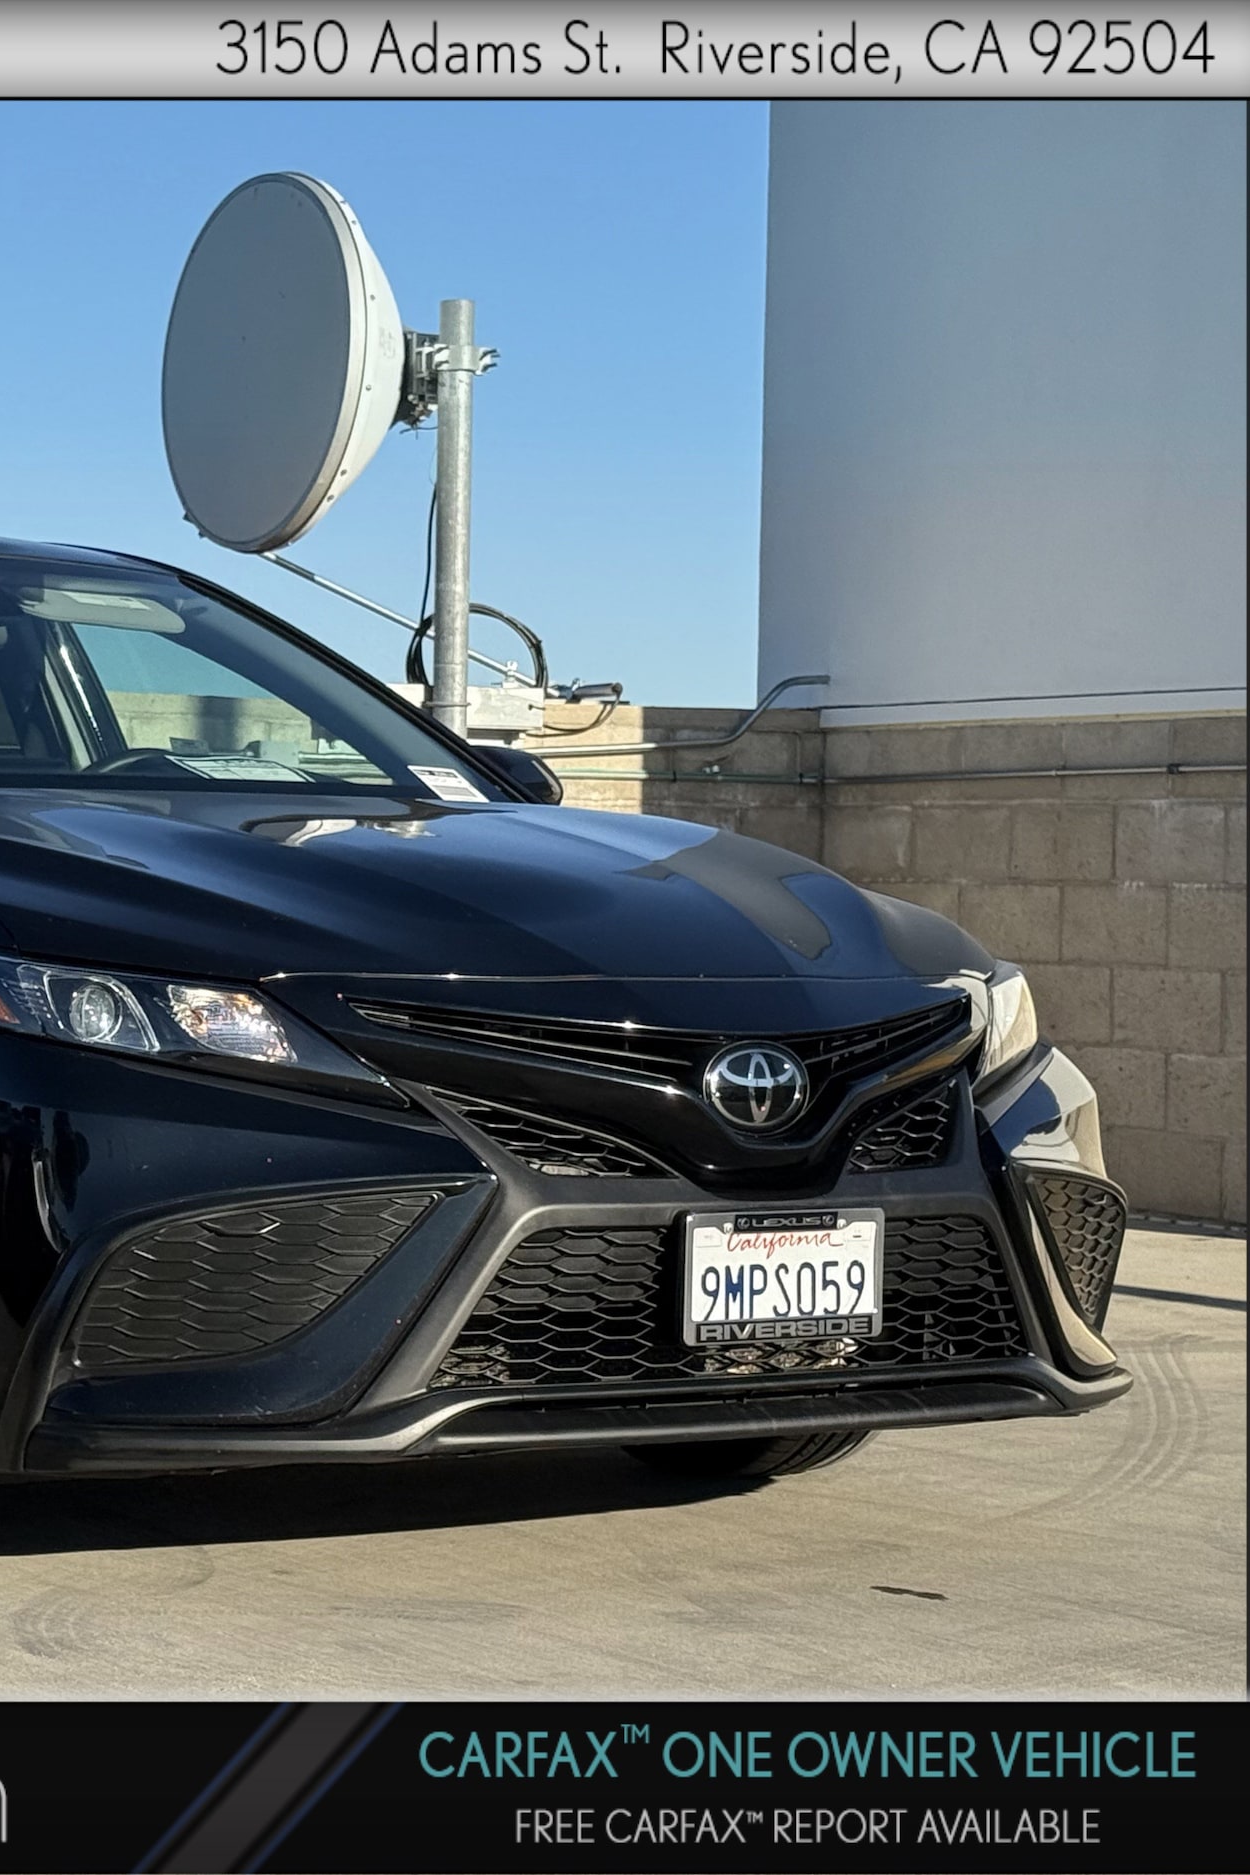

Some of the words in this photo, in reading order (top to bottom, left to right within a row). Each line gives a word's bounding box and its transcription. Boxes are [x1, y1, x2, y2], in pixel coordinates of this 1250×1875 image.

[751, 1215, 821, 1228] LEXUS
[726, 1231, 844, 1259] California
[700, 1259, 866, 1321] 9MPS059
[699, 1317, 871, 1343] RIVERSIDE
